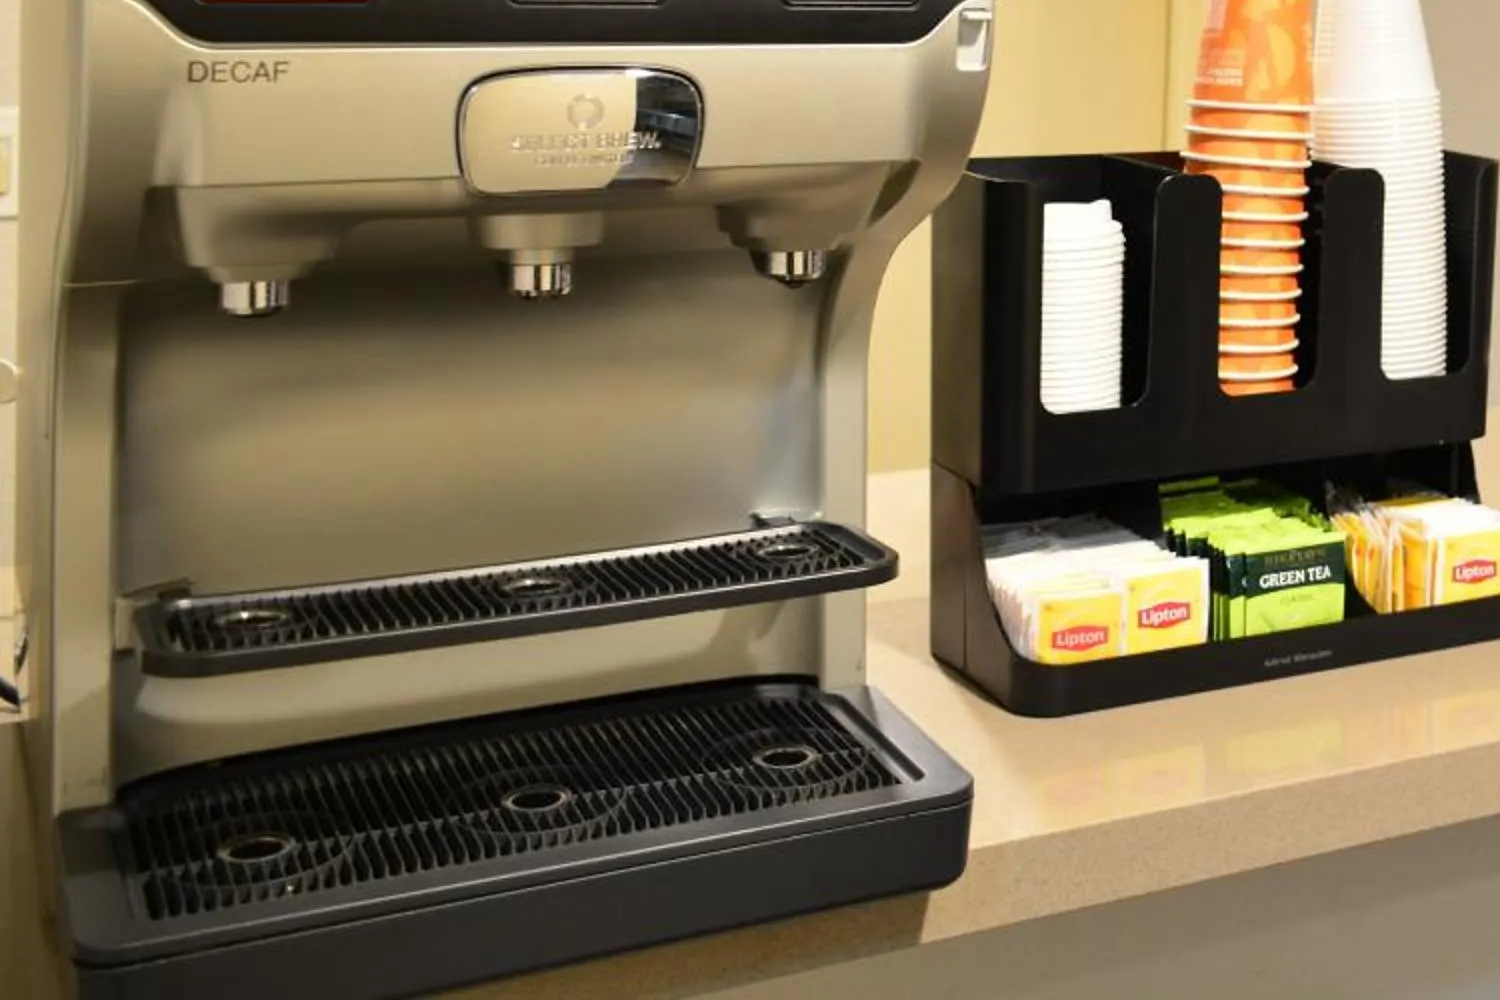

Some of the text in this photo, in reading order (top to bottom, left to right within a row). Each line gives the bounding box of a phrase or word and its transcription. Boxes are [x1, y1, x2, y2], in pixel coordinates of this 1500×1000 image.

[187, 61, 289, 84] DECAF
[1258, 564, 1332, 589] GREEN TEA
[1455, 564, 1495, 583] Lipton
[1141, 605, 1187, 627] Lipton
[1056, 630, 1105, 648] Lipton
